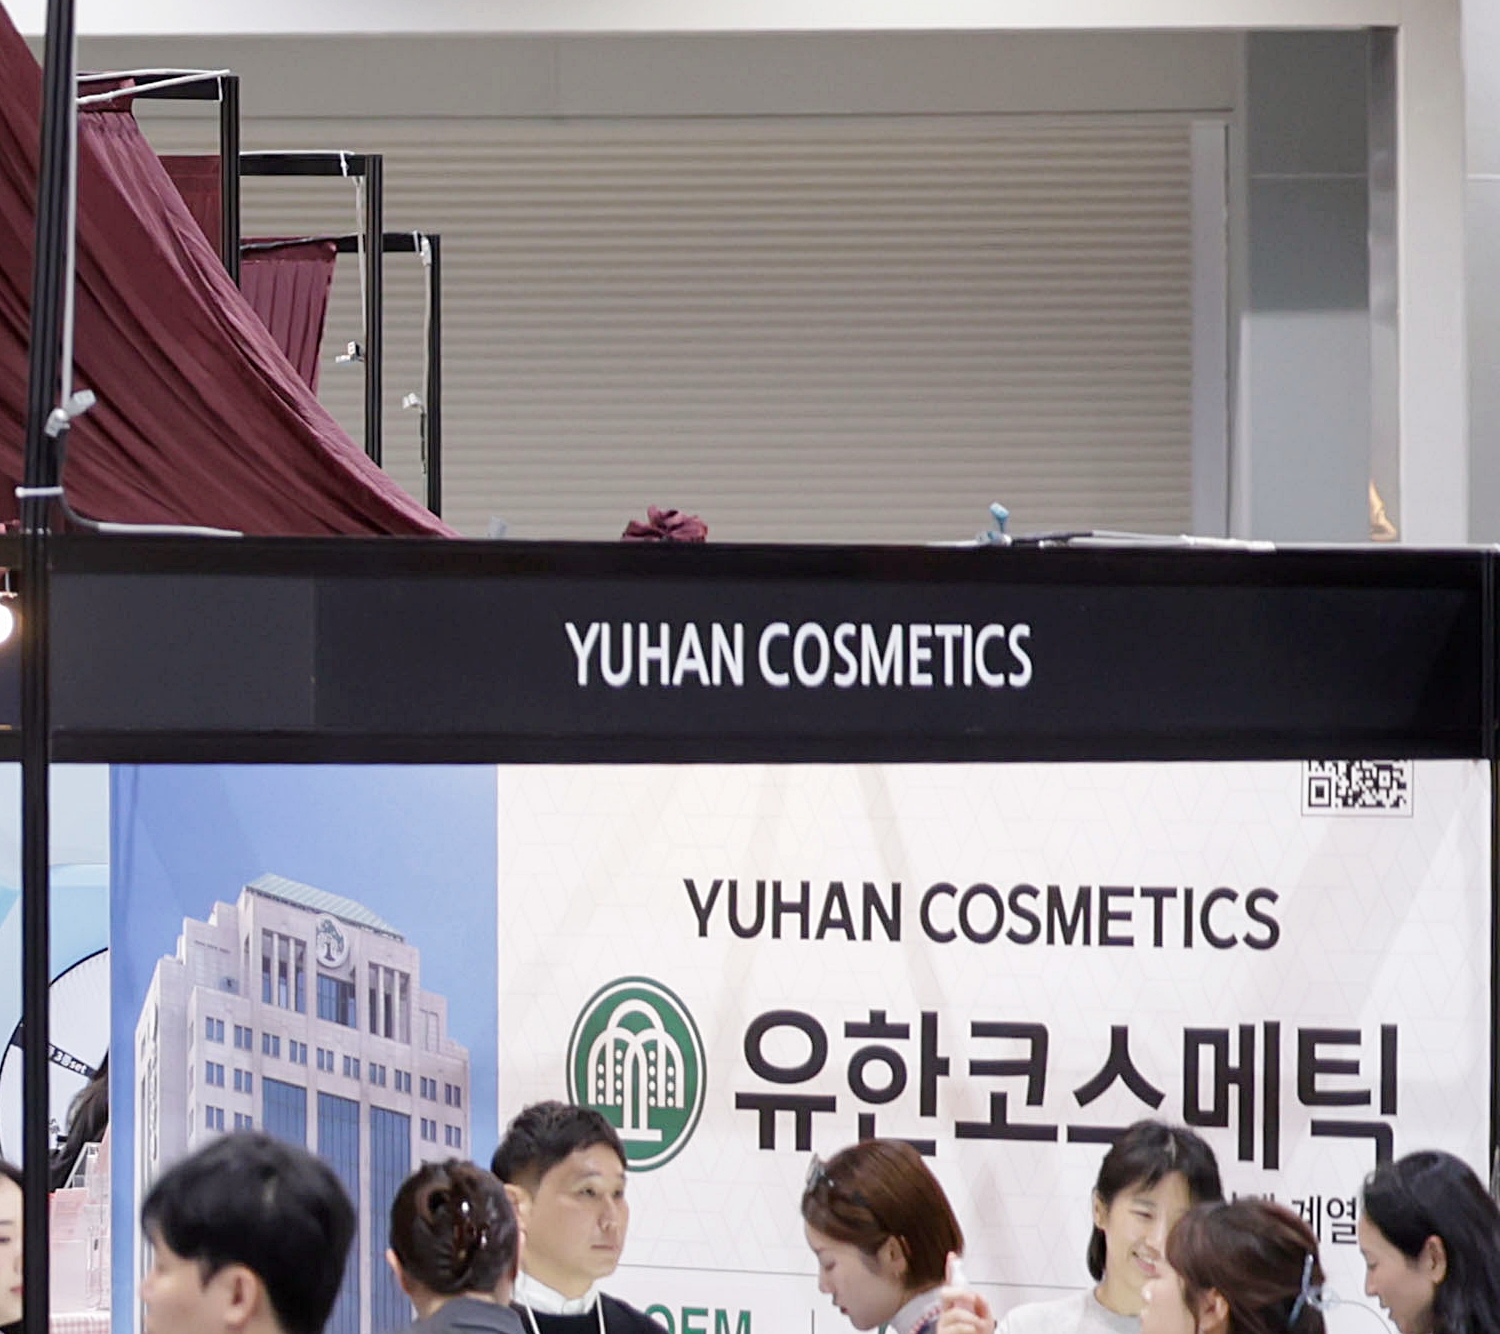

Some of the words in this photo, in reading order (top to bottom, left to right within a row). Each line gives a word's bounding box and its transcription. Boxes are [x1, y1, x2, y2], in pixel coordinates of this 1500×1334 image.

[565, 621, 745, 687] YUHAN
[758, 621, 1033, 688] COSMETICS
[683, 877, 902, 942] YUHAN
[919, 881, 1282, 951] COSMETICS
[734, 1008, 1401, 1171] 유한코스메틱
